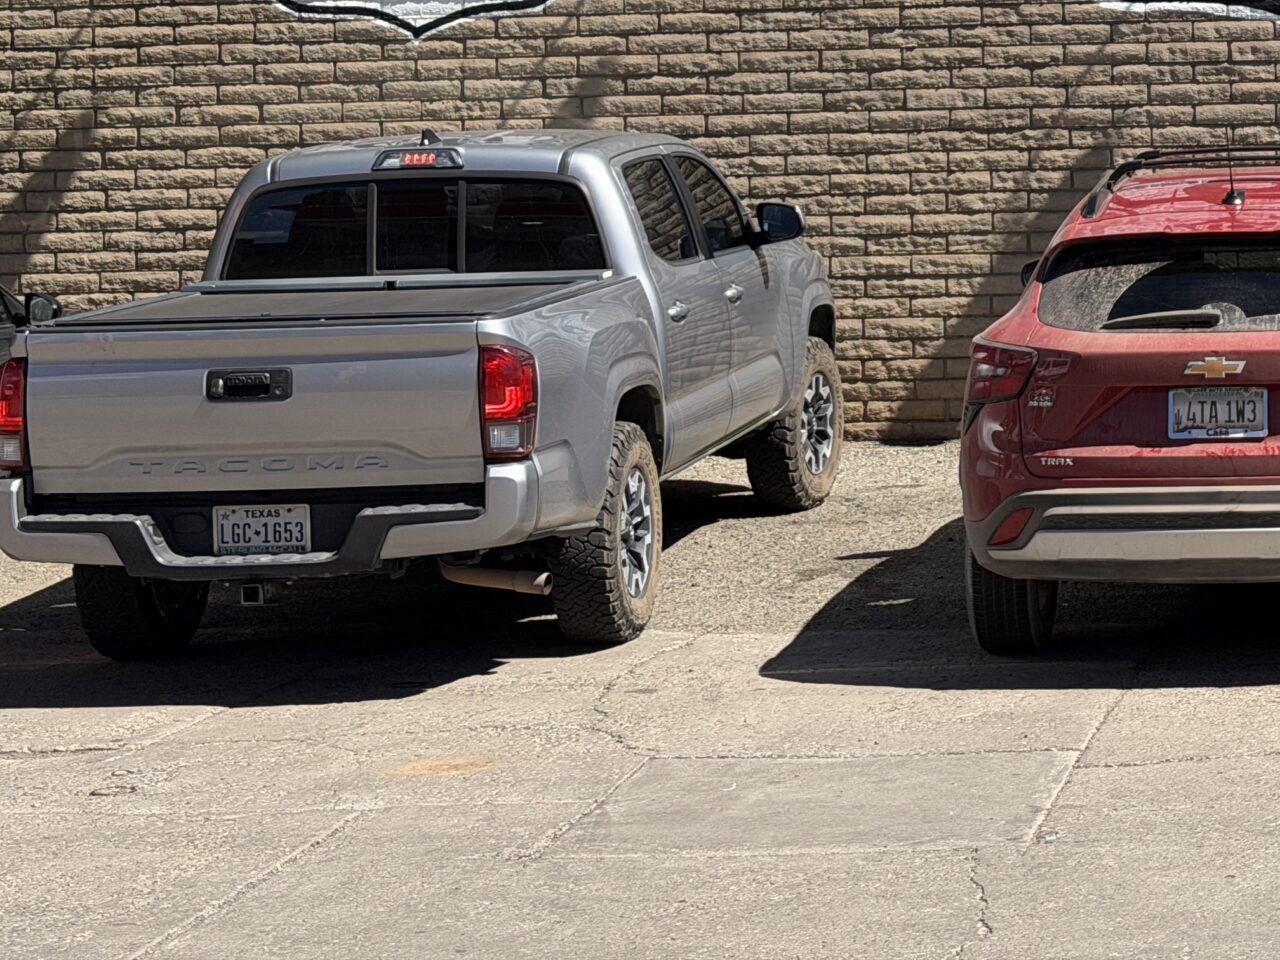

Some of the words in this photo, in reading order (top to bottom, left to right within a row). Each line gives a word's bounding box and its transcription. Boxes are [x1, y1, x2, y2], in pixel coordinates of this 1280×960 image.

[1187, 401, 1218, 423] 4TA
[1225, 400, 1256, 422] 1W3
[129, 454, 389, 475] TACOMA
[1040, 457, 1074, 466] TRAX
[244, 509, 281, 519] TEXAS
[220, 522, 252, 544] LGC
[262, 521, 304, 543] 1653
